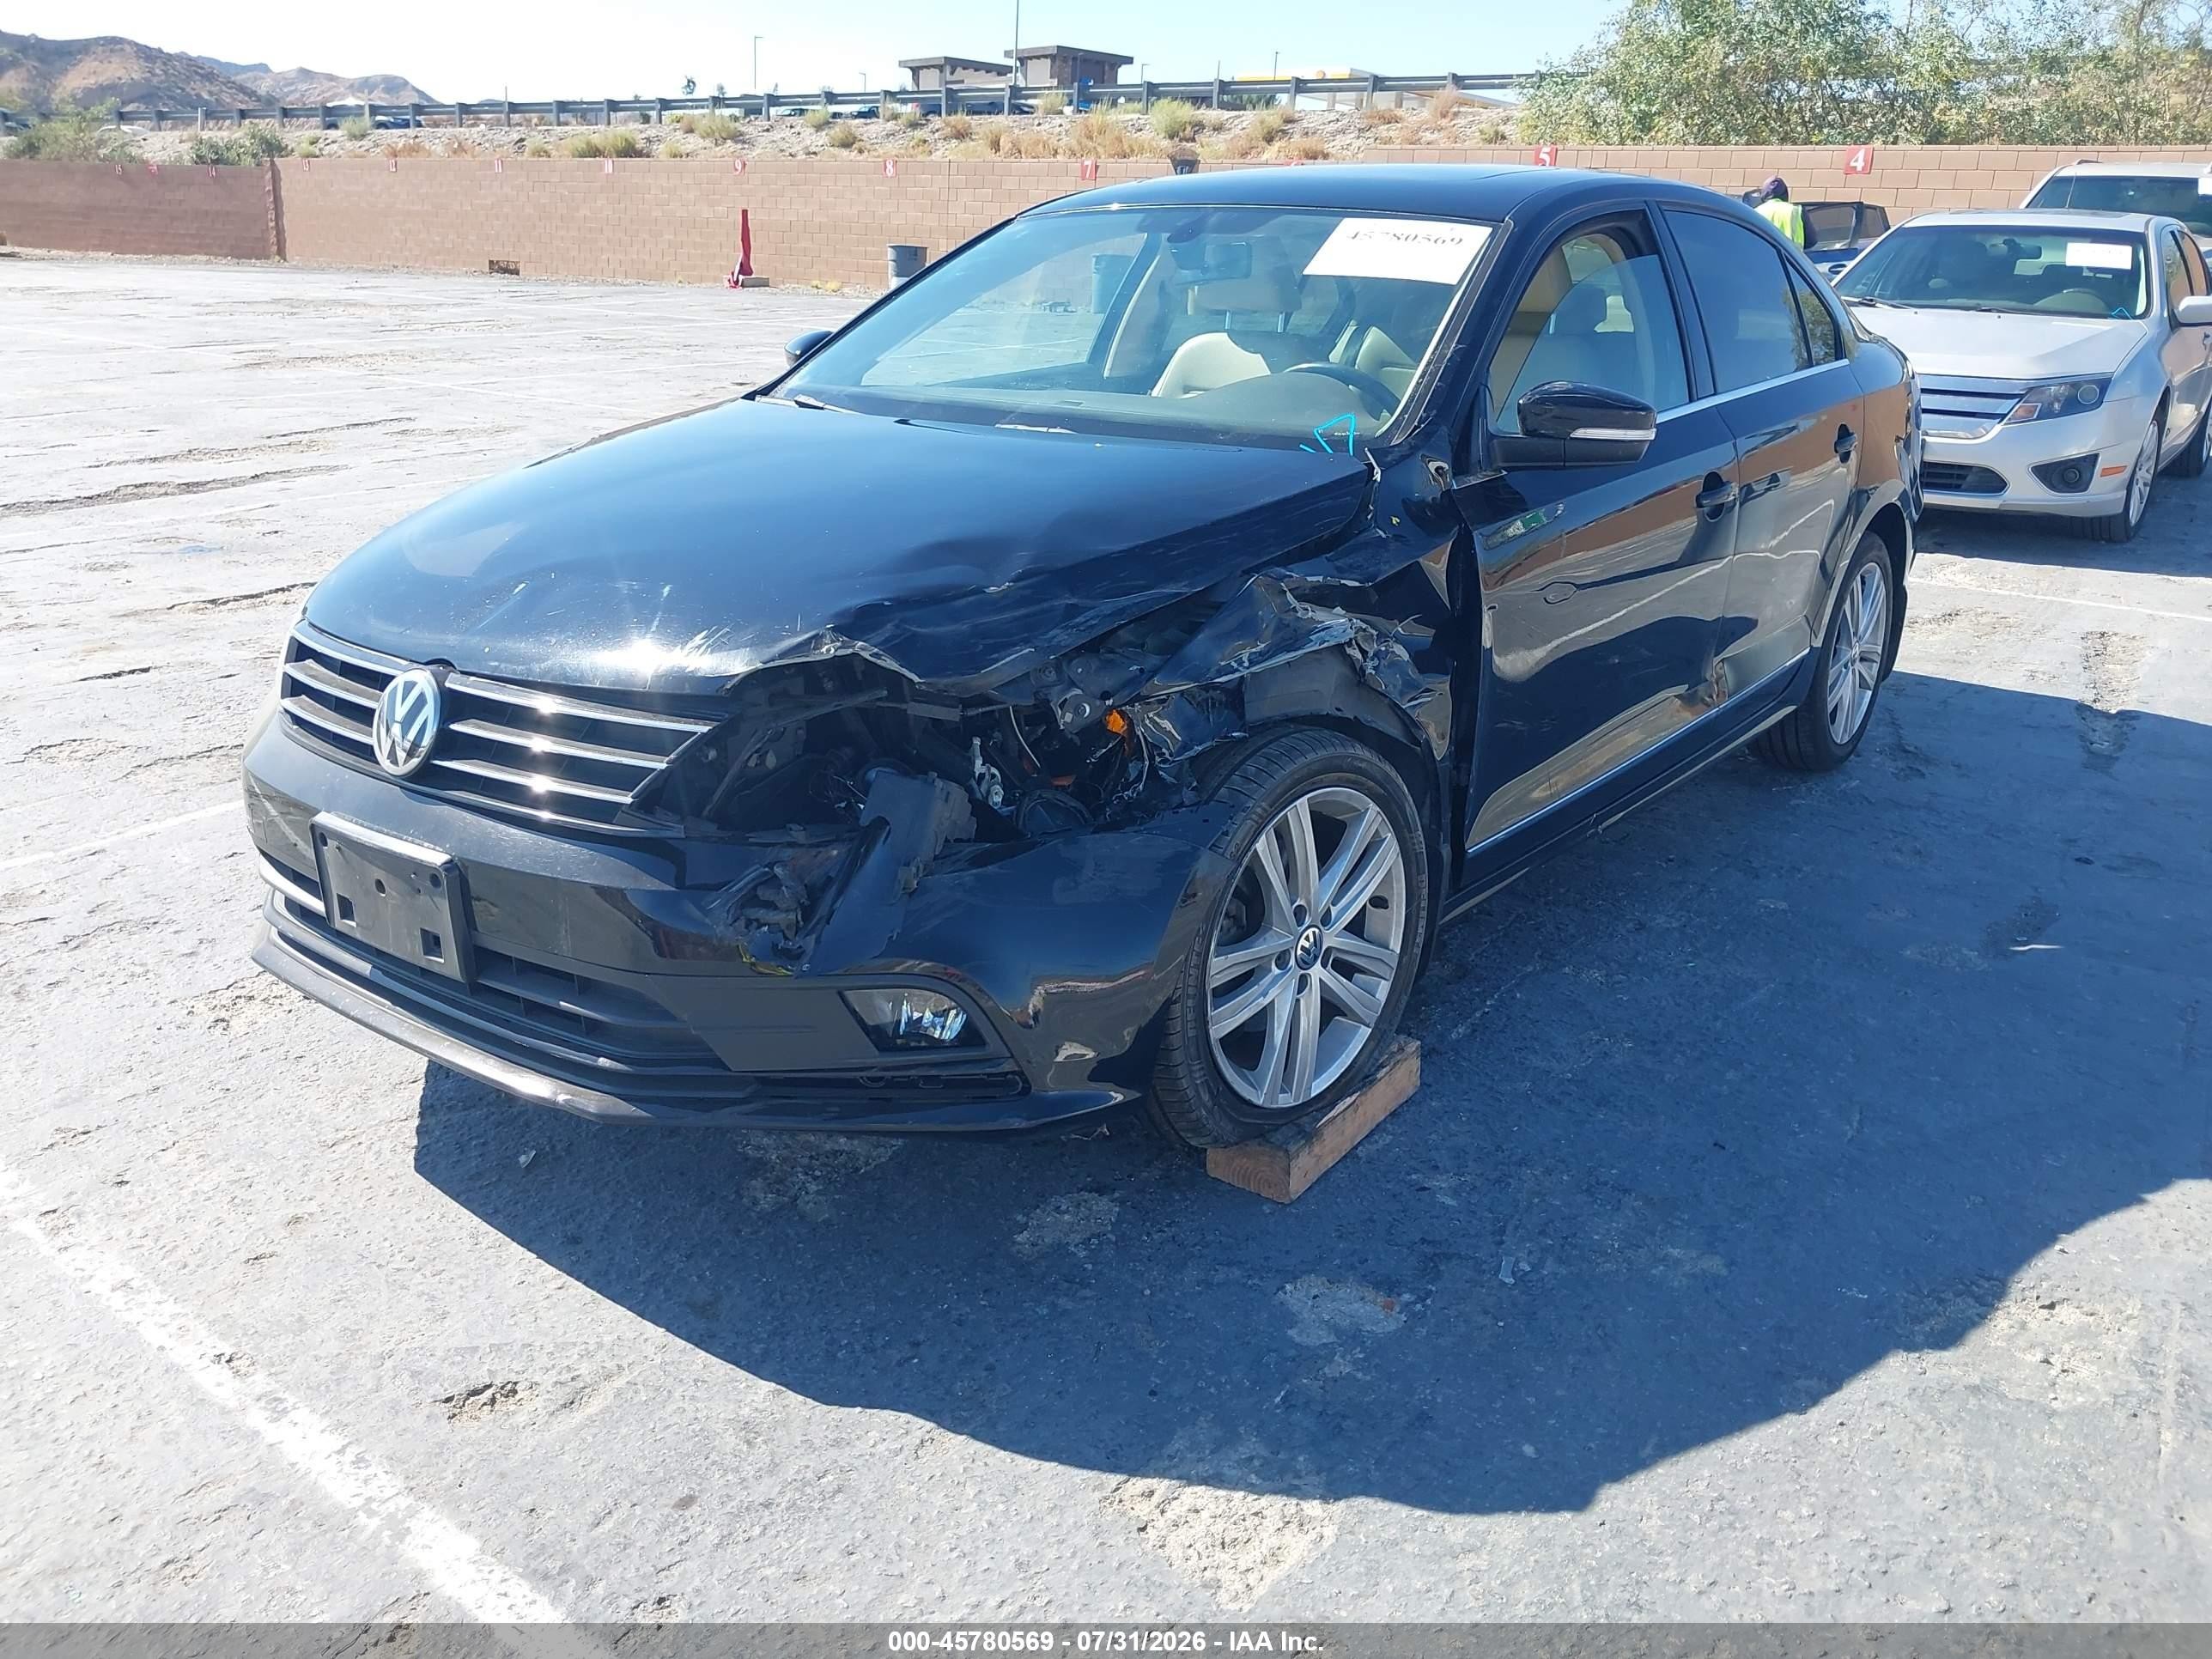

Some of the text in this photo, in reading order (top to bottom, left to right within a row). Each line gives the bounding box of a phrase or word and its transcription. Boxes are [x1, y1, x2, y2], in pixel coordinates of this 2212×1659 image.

[734, 158, 742, 175] 9
[1538, 147, 1551, 167] 5
[1849, 148, 1866, 172] 4
[885, 160, 894, 177] 8
[1083, 160, 1092, 179] 7
